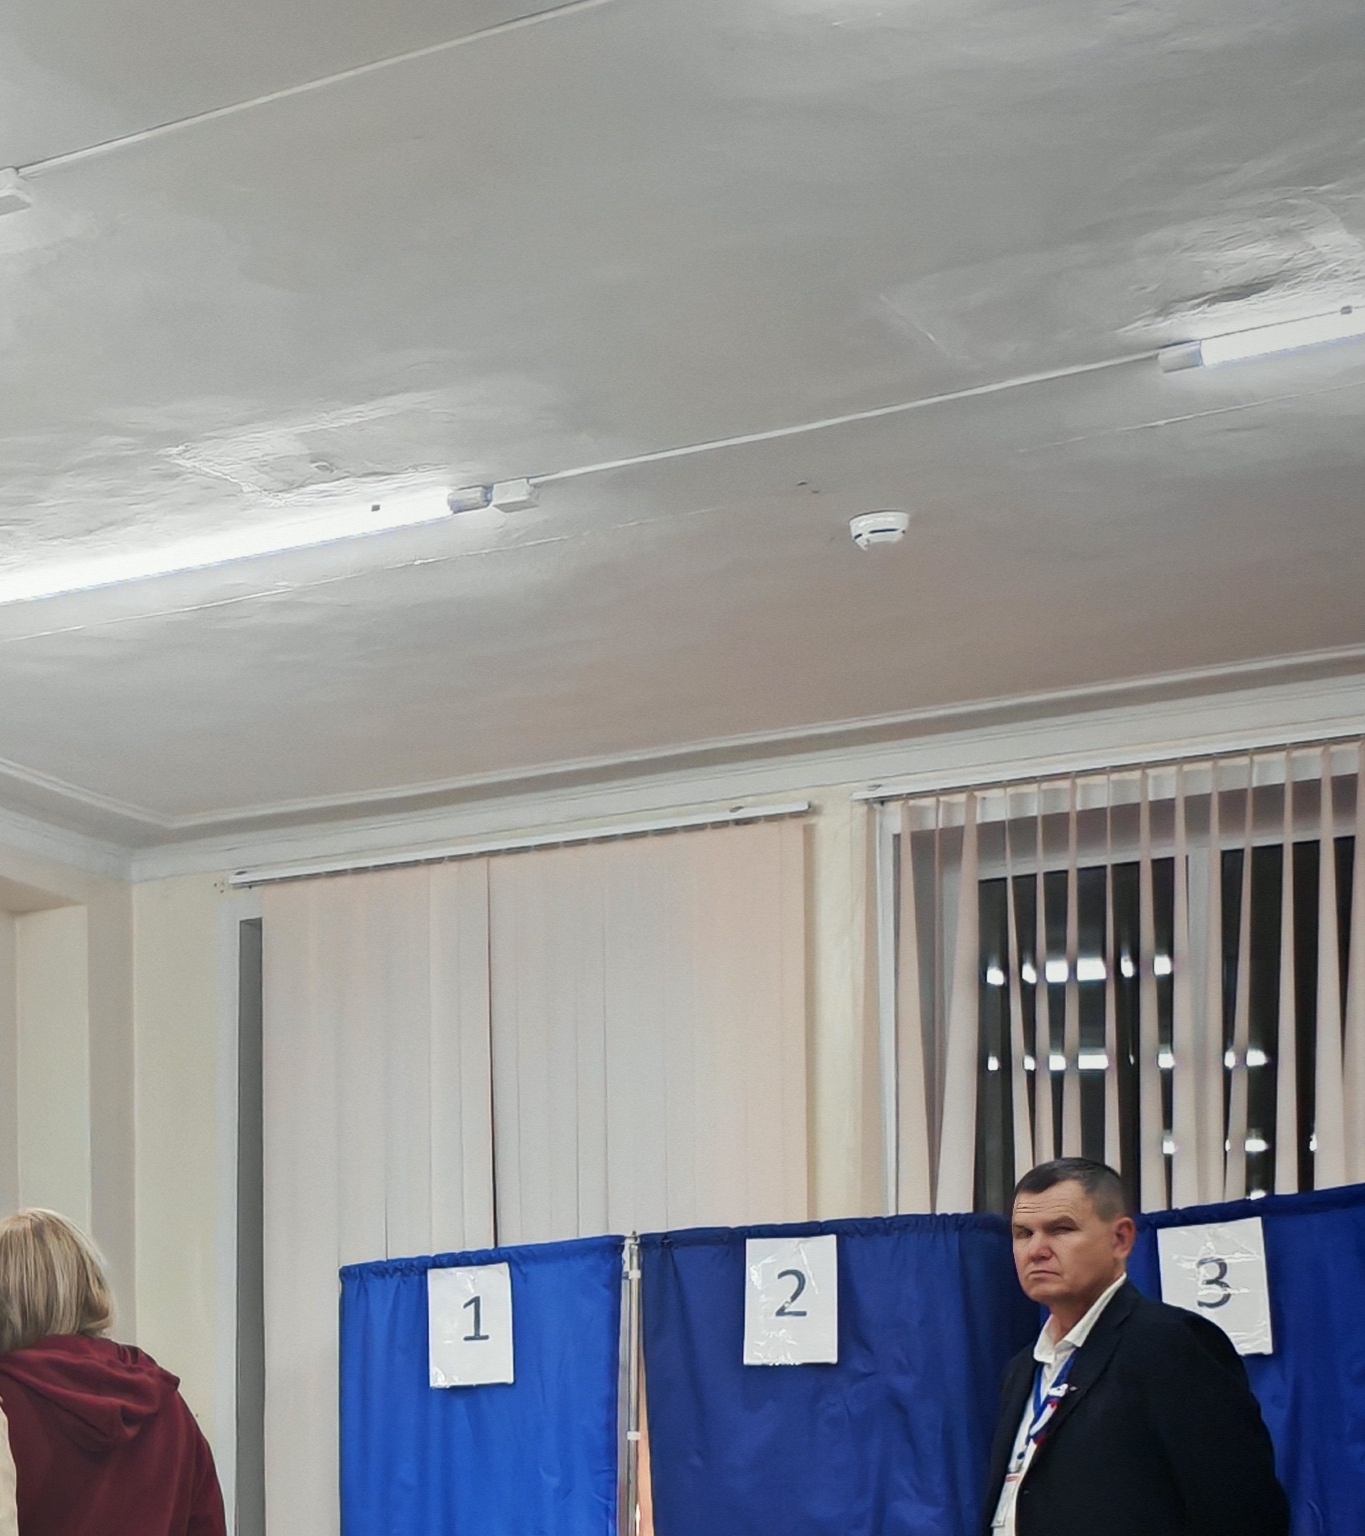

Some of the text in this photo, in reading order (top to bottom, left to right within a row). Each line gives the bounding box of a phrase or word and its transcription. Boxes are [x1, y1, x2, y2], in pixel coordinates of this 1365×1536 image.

[775, 1268, 808, 1318] 2
[1196, 1257, 1232, 1309] 3
[462, 1295, 490, 1342] 1
